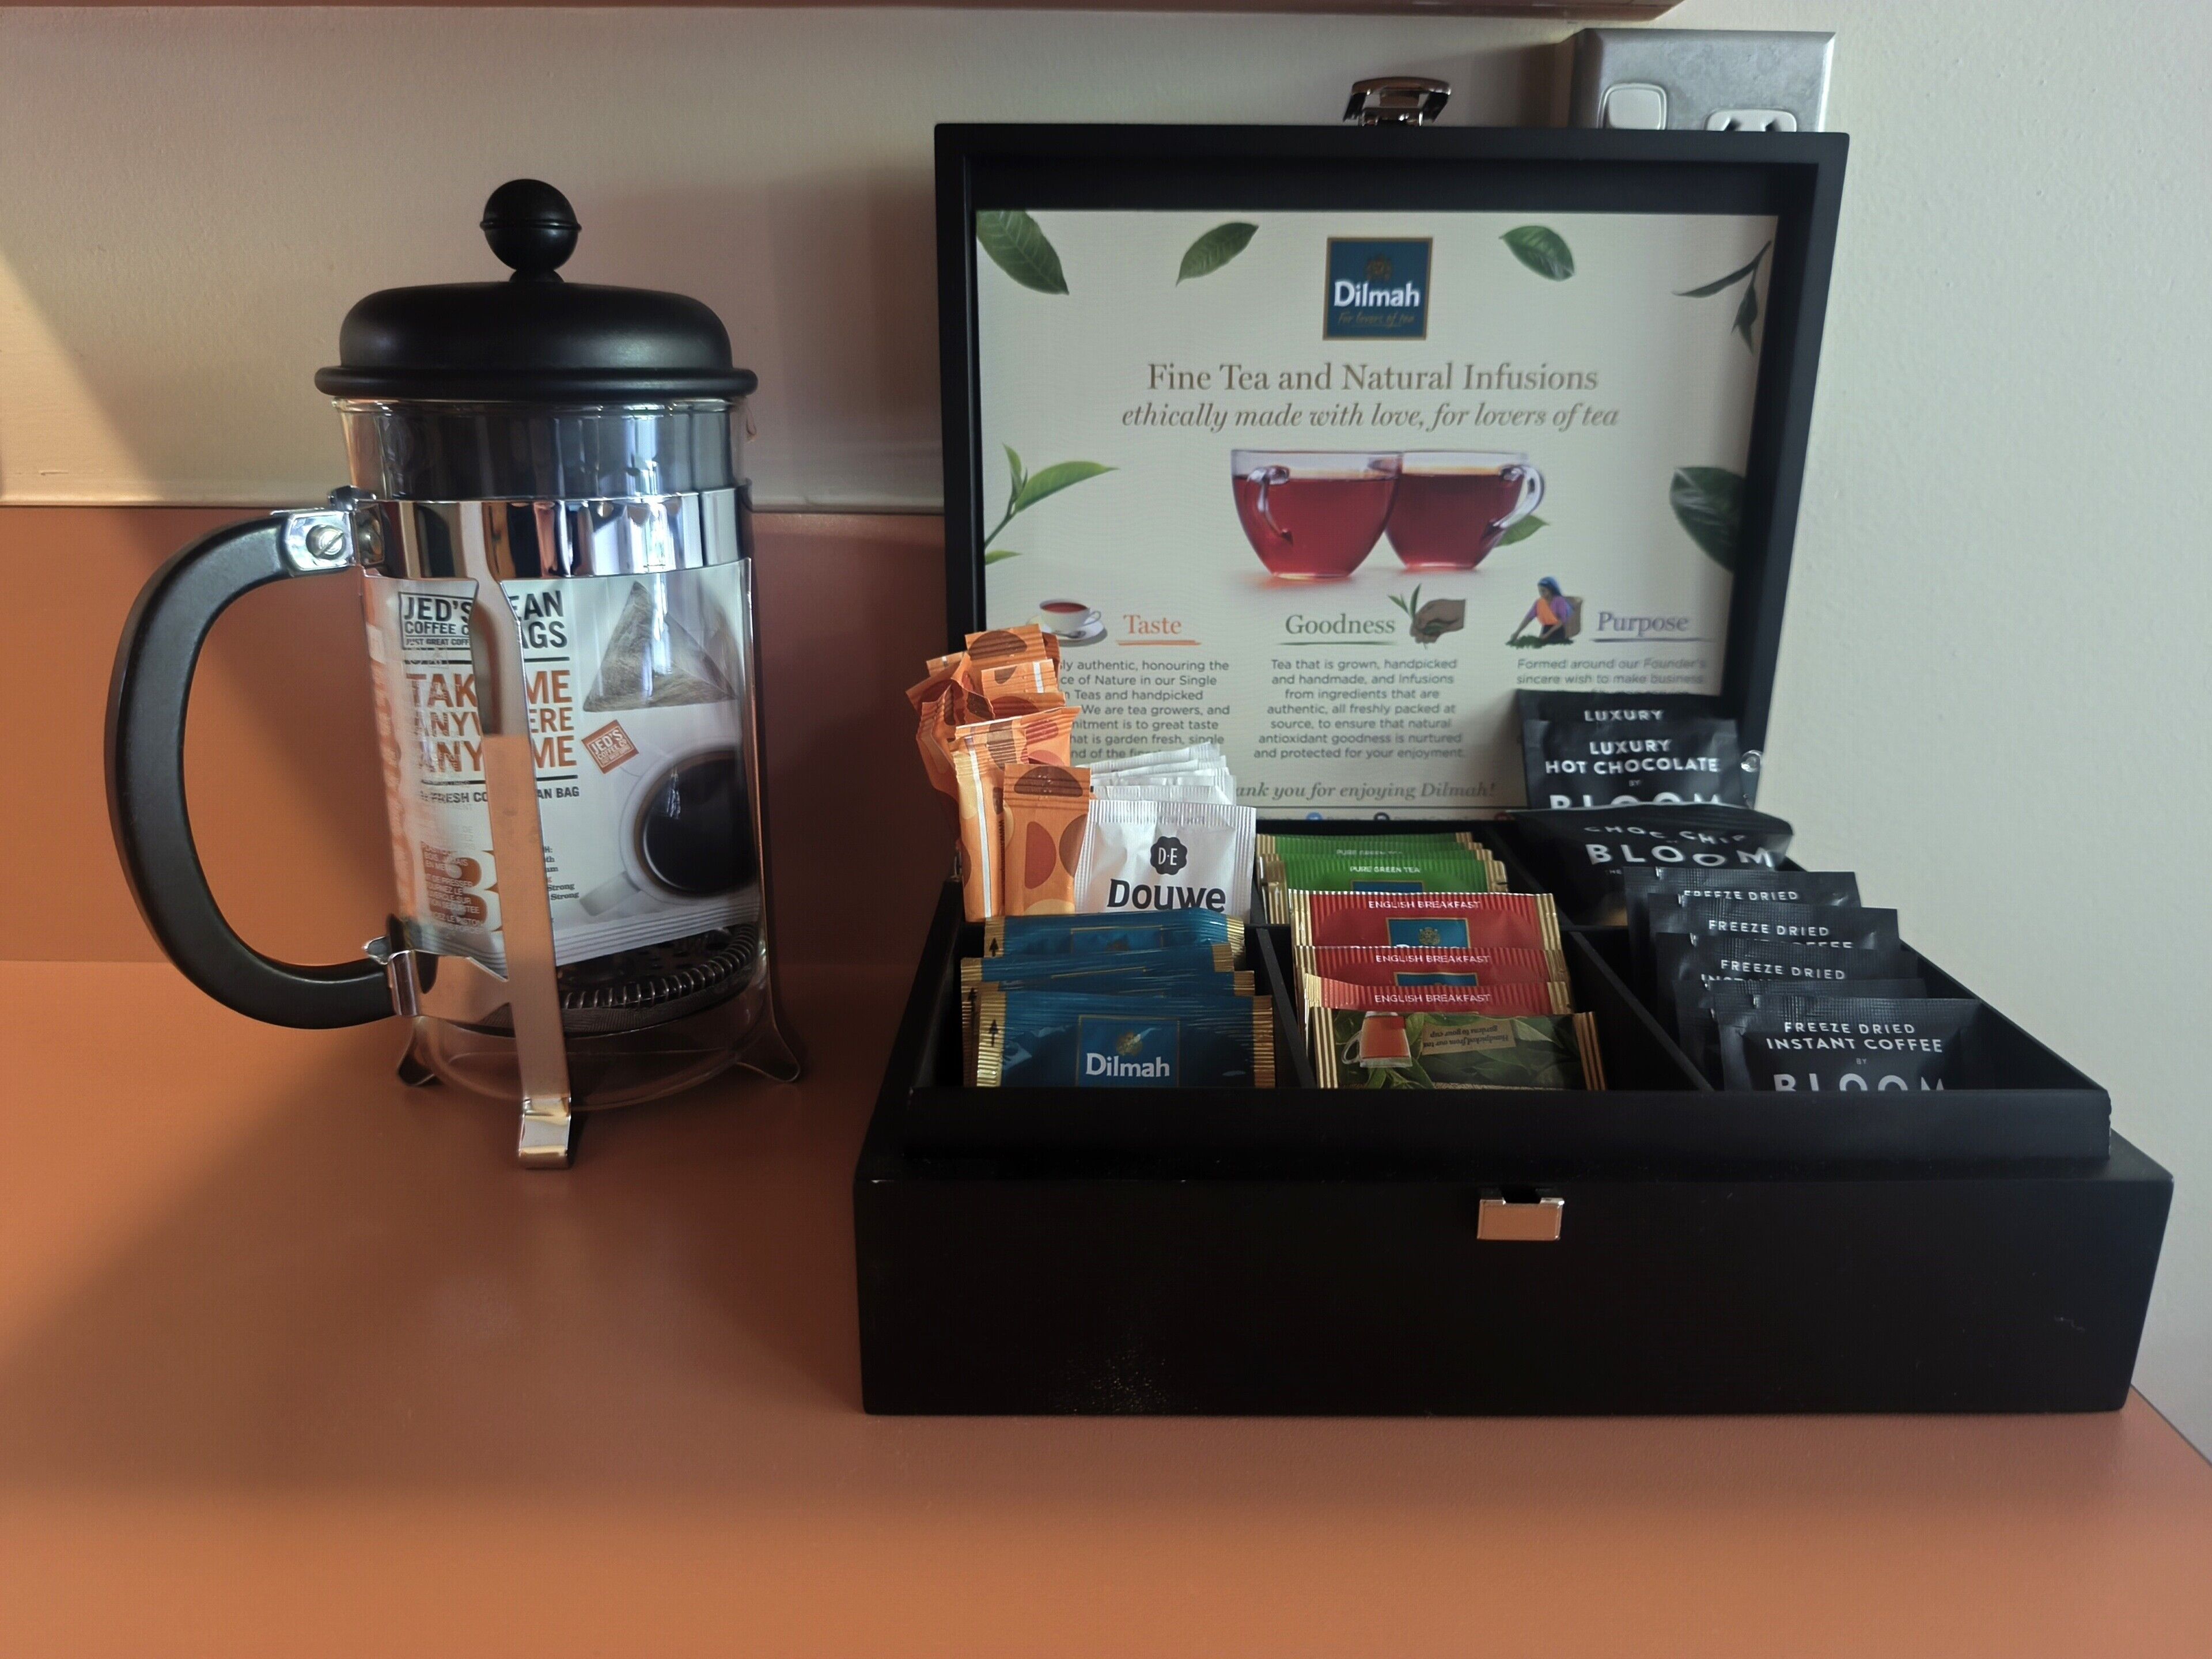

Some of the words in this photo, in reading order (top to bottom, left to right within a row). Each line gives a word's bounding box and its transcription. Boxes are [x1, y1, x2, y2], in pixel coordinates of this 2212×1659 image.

[1334, 281, 1421, 307] Dilmah
[1148, 363, 1211, 390] Fine
[1219, 364, 1270, 390] Tea
[1278, 363, 1332, 390] and
[1342, 363, 1452, 390] Natural
[1463, 363, 1598, 390] Infusions
[1122, 403, 1228, 433] ethically
[1235, 403, 1302, 426] made
[1310, 403, 1363, 426] with
[1372, 403, 1423, 430] love,
[1426, 403, 1468, 432] for
[1475, 403, 1546, 426] lovers
[1552, 403, 1584, 433] of
[1582, 406, 1619, 426] tea
[404, 597, 472, 623] JED'S
[405, 621, 456, 635] COFFEE
[1123, 614, 1181, 634] Taste
[1285, 613, 1396, 635] Goodness
[1598, 612, 1688, 636] Purpose
[1077, 661, 1138, 672] authentic,
[1142, 661, 1205, 672] honouring
[1210, 661, 1229, 671] the
[1271, 660, 1291, 669] Tea
[1296, 660, 1320, 669] that
[1324, 660, 1334, 669] is
[1338, 661, 1380, 672] grown,
[1384, 659, 1457, 671] handpicked
[1517, 660, 1566, 669] Formed
[1570, 660, 1613, 669] around
[1618, 661, 1638, 669] our
[1643, 658, 1706, 669] Founder's
[1078, 675, 1090, 685] of
[1095, 676, 1136, 685] Nature
[1141, 675, 1150, 685] in
[1154, 677, 1175, 685] our
[1180, 675, 1217, 687] Single
[1271, 675, 1294, 684] and
[1299, 675, 1367, 685] handmade,
[1371, 675, 1394, 684] and
[1399, 674, 1455, 684] Infusions
[1517, 674, 1560, 684] sincere
[1565, 674, 1592, 684] wish
[1597, 675, 1609, 684] to
[1613, 674, 1647, 684] make
[1650, 673, 1703, 684] business
[406, 673, 478, 708] TAK
[1074, 690, 1101, 700] Teas
[1105, 690, 1128, 700] and
[1131, 690, 1203, 702] handpicked
[1285, 689, 1313, 699] from
[1318, 689, 1387, 700] ingredients
[1392, 689, 1415, 699] that
[1419, 691, 1439, 699] are
[1081, 704, 1101, 714] We
[1105, 707, 1123, 715] are
[1128, 706, 1146, 715] tea
[1151, 706, 1203, 717] growers,
[1207, 704, 1230, 715] and
[1267, 704, 1328, 715] authentic,
[1332, 704, 1346, 714] all
[1350, 704, 1389, 716] freshly
[1395, 704, 1440, 716] packed
[1443, 704, 1455, 714] at
[1584, 710, 1664, 721] LUXURY
[1123, 720, 1132, 729] is
[1136, 721, 1148, 729] to
[1152, 721, 1184, 732] great
[1188, 721, 1218, 730] taste
[1271, 721, 1314, 730] source,
[1319, 720, 1331, 729] to
[1335, 721, 1376, 729] ensure
[1380, 719, 1404, 729] that
[1408, 719, 1451, 729] natural
[591, 729, 623, 755] JED'S
[1070, 734, 1088, 744] hat
[1093, 735, 1101, 744] is
[1105, 734, 1147, 746] garden
[1152, 734, 1184, 745] fresh,
[1189, 735, 1224, 745] single
[1258, 733, 1327, 744] antioxidant
[1331, 733, 1391, 745] goodness
[1395, 733, 1404, 743] is
[1408, 733, 1461, 743] nurtured
[1589, 739, 1671, 755] LUXURY
[1090, 749, 1103, 759] of
[1107, 749, 1126, 759] the
[1253, 748, 1277, 759] and
[1281, 748, 1341, 760] protected
[1345, 748, 1361, 758] for
[1365, 750, 1393, 760] your
[1397, 748, 1465, 760] enjoyment.
[1546, 760, 1588, 774] HOT
[1593, 757, 1721, 774] CHOCOLATE
[556, 787, 579, 798] BAG
[1236, 782, 1269, 797] ank
[1273, 786, 1306, 801] you
[1306, 782, 1335, 801] for
[1340, 782, 1415, 801] enjoying
[1421, 782, 1495, 797] Dilmah!
[1584, 826, 1665, 839] CHOC
[1679, 831, 1747, 844] CHIP
[1585, 844, 1773, 868] BLOOM
[548, 884, 575, 892] Strong
[551, 892, 579, 900] Strong
[1107, 878, 1226, 912] Douwe
[1748, 891, 1798, 900] DRIED
[1709, 920, 1770, 934] FREEZE
[1777, 925, 1830, 936] DRIED
[1376, 955, 1422, 963] ENGLISH
[1426, 955, 1490, 963] BREAKFAST
[1721, 959, 1783, 975] FREEZE
[1791, 967, 1845, 980] DRIED
[1375, 994, 1423, 1003] ENGLISH
[1426, 993, 1492, 1002] BREAKFAST
[1784, 1022, 1851, 1033] FREEZE
[1859, 1024, 1915, 1034] DRIED
[1766, 1038, 1855, 1050] INSTANT
[1864, 1039, 1942, 1053] COFFEE
[1086, 1053, 1170, 1077] Dilmah
